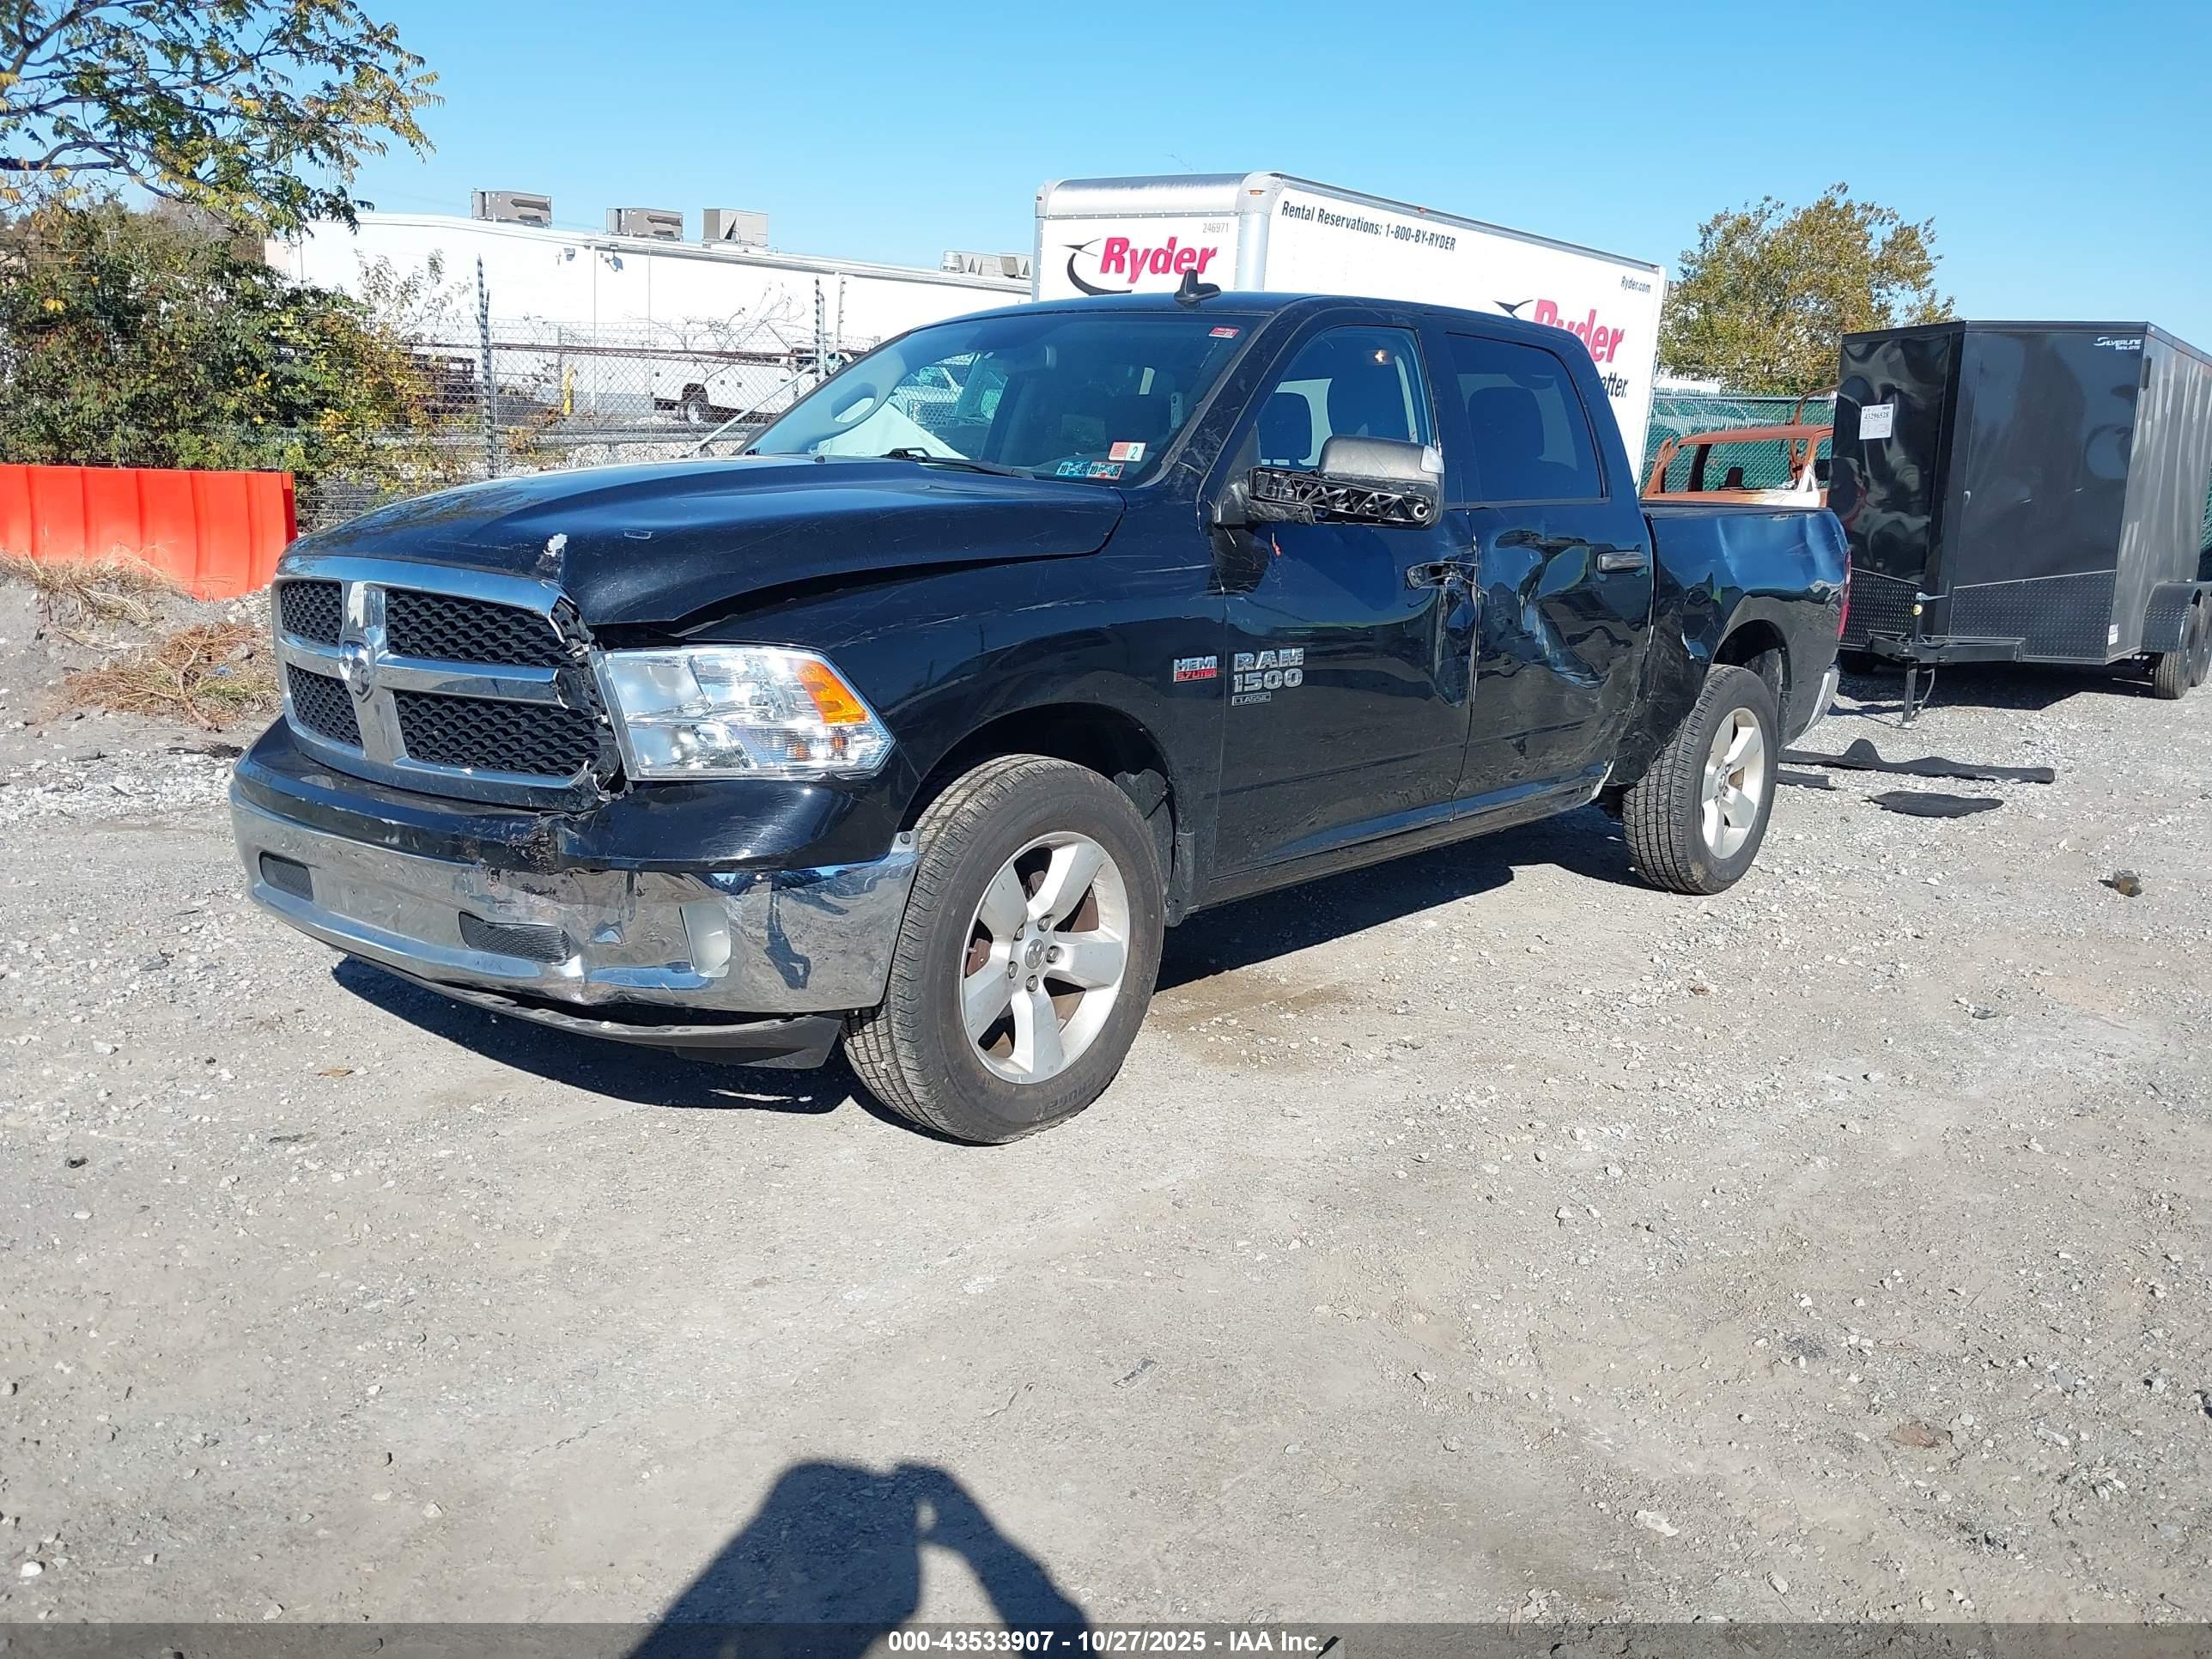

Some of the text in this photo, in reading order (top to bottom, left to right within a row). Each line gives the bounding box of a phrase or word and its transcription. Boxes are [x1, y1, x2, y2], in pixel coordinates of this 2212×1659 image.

[1202, 222, 1230, 234] 246971
[1281, 200, 1456, 252] Rental Reservations: 1-800-BY-RYDER
[1099, 236, 1218, 284] Ryder
[1620, 276, 1651, 294] Ryder.com
[1129, 446, 1139, 459] 2
[1174, 655, 1218, 672] HEMI
[1233, 647, 1304, 672] RAM
[1176, 669, 1217, 681] 5.7 LITER
[1233, 668, 1304, 693] 1500
[1234, 693, 1270, 705] CLASSIC
